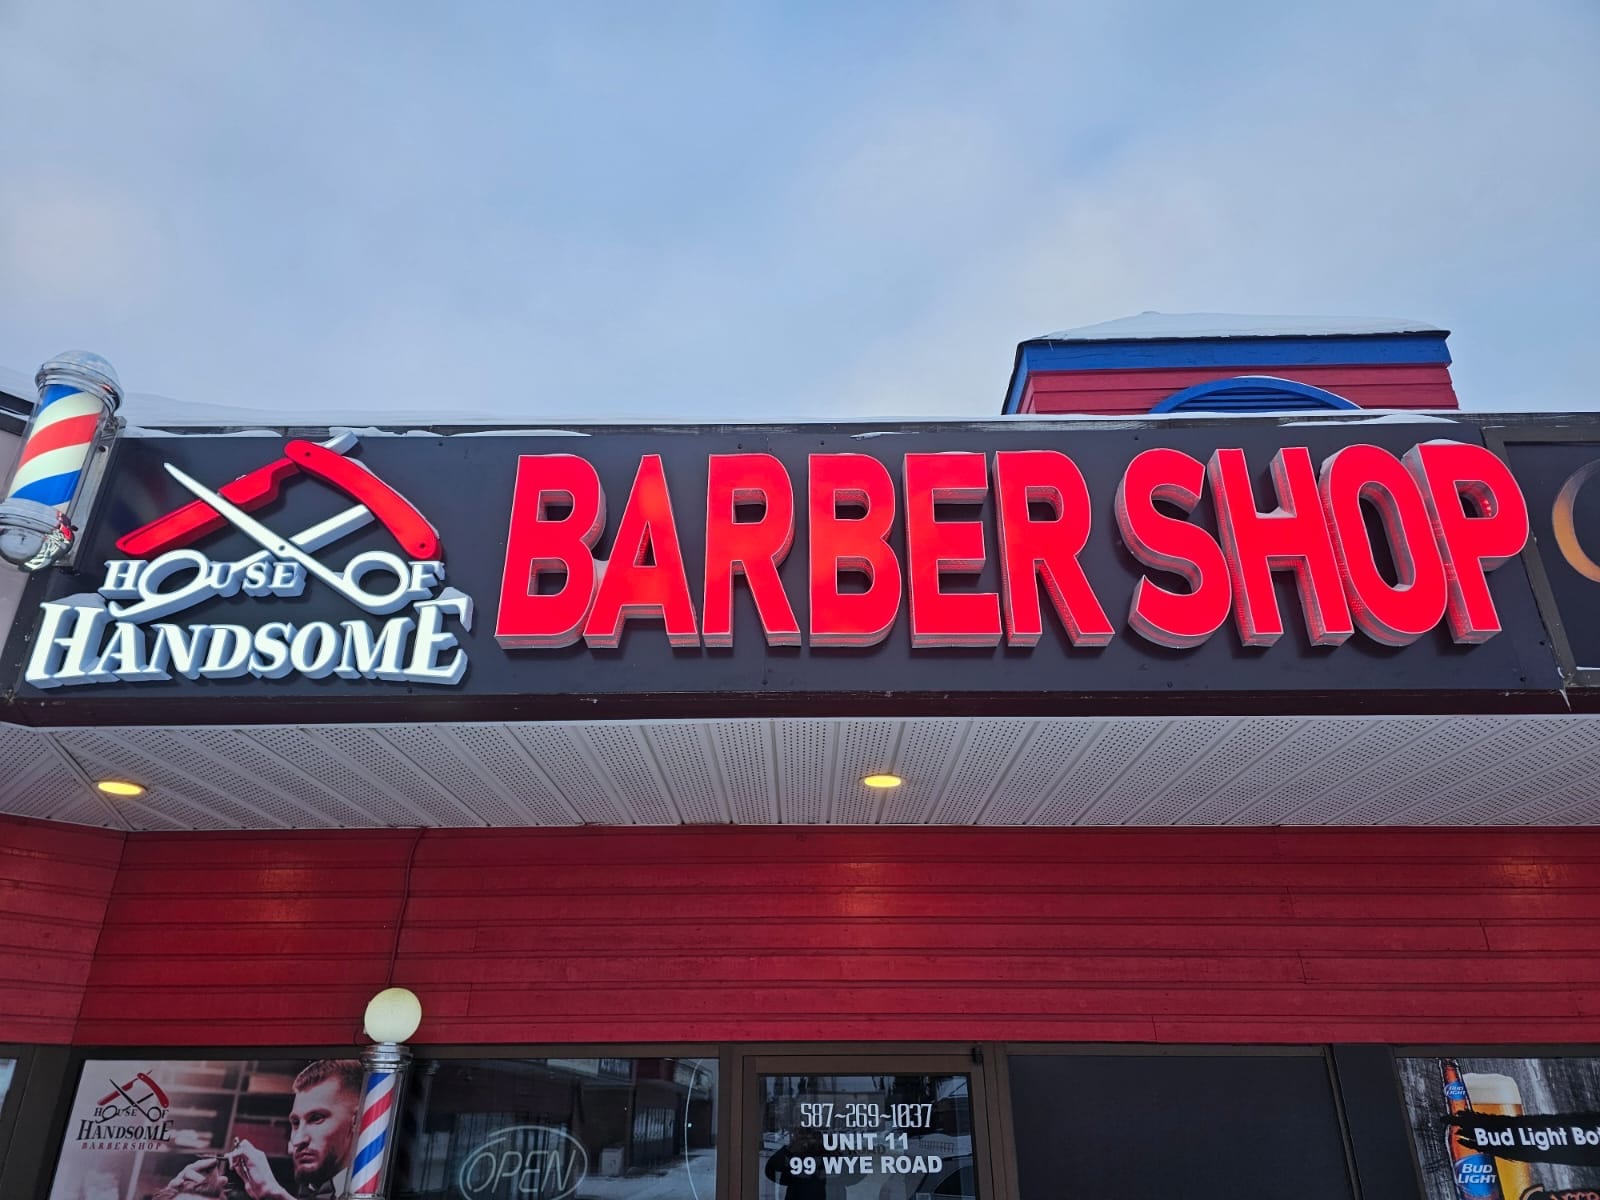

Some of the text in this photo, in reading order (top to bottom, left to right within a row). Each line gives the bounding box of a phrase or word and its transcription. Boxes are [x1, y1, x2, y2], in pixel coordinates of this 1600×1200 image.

[494, 440, 1530, 648] BARBER SHOP
[100, 549, 446, 612] HOUSE OF
[25, 588, 474, 689] HANDSOME
[94, 1105, 137, 1121] HOUSE
[76, 1119, 174, 1142] HANDSOME
[1474, 1127, 1515, 1146] Bud
[1518, 1127, 1568, 1150] Light
[81, 1141, 162, 1150] BARBERSHOP
[823, 1132, 909, 1151] UNIT 11
[466, 1150, 576, 1193] OPEN
[789, 1155, 943, 1175] 99 WYE ROAD
[1462, 1163, 1493, 1174] BUD
[1458, 1173, 1497, 1184] LIGHT
